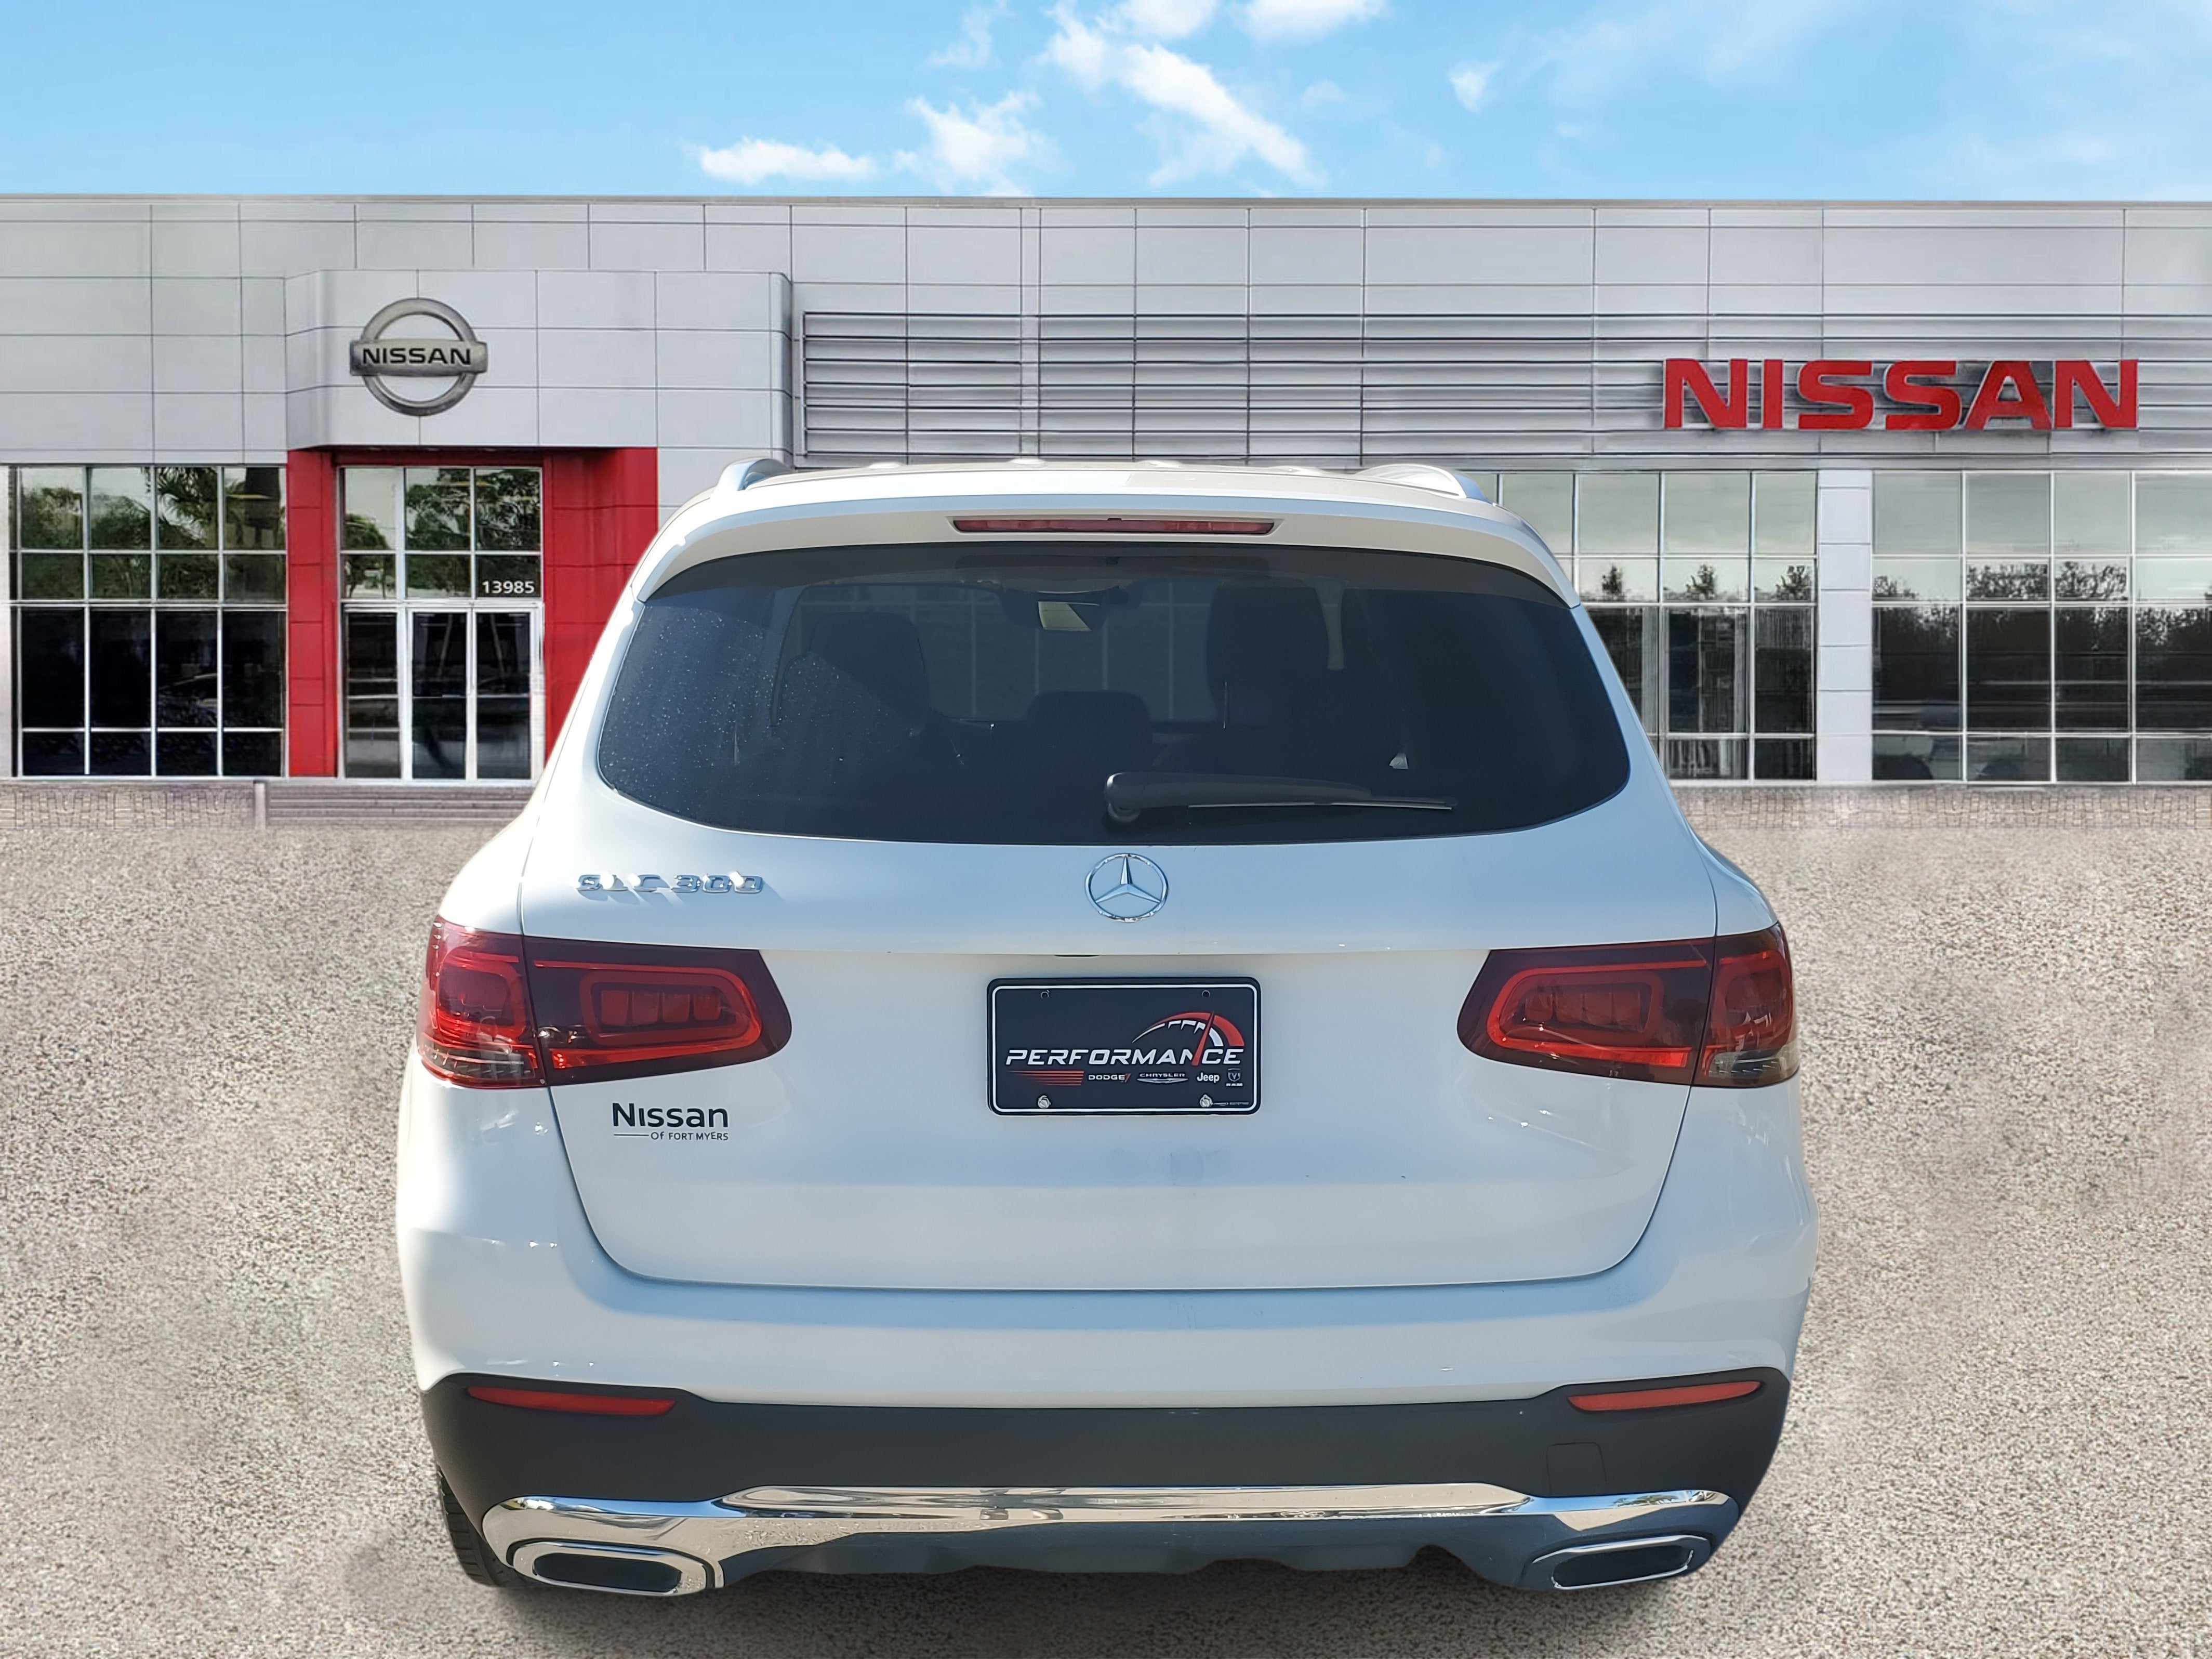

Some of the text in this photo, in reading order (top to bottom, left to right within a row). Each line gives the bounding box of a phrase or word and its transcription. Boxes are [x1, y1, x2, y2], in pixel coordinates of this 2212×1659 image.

[363, 348, 471, 364] NISSAN
[1664, 359, 2138, 429] NISSAN
[482, 581, 534, 594] 13985
[672, 871, 763, 893] 300
[1005, 1048, 1244, 1065] PERFORMANCE
[1197, 1072, 1220, 1083] Jeep
[612, 1102, 728, 1128] Nissan
[668, 1132, 694, 1140] FORT
[696, 1131, 728, 1141] MYERS
